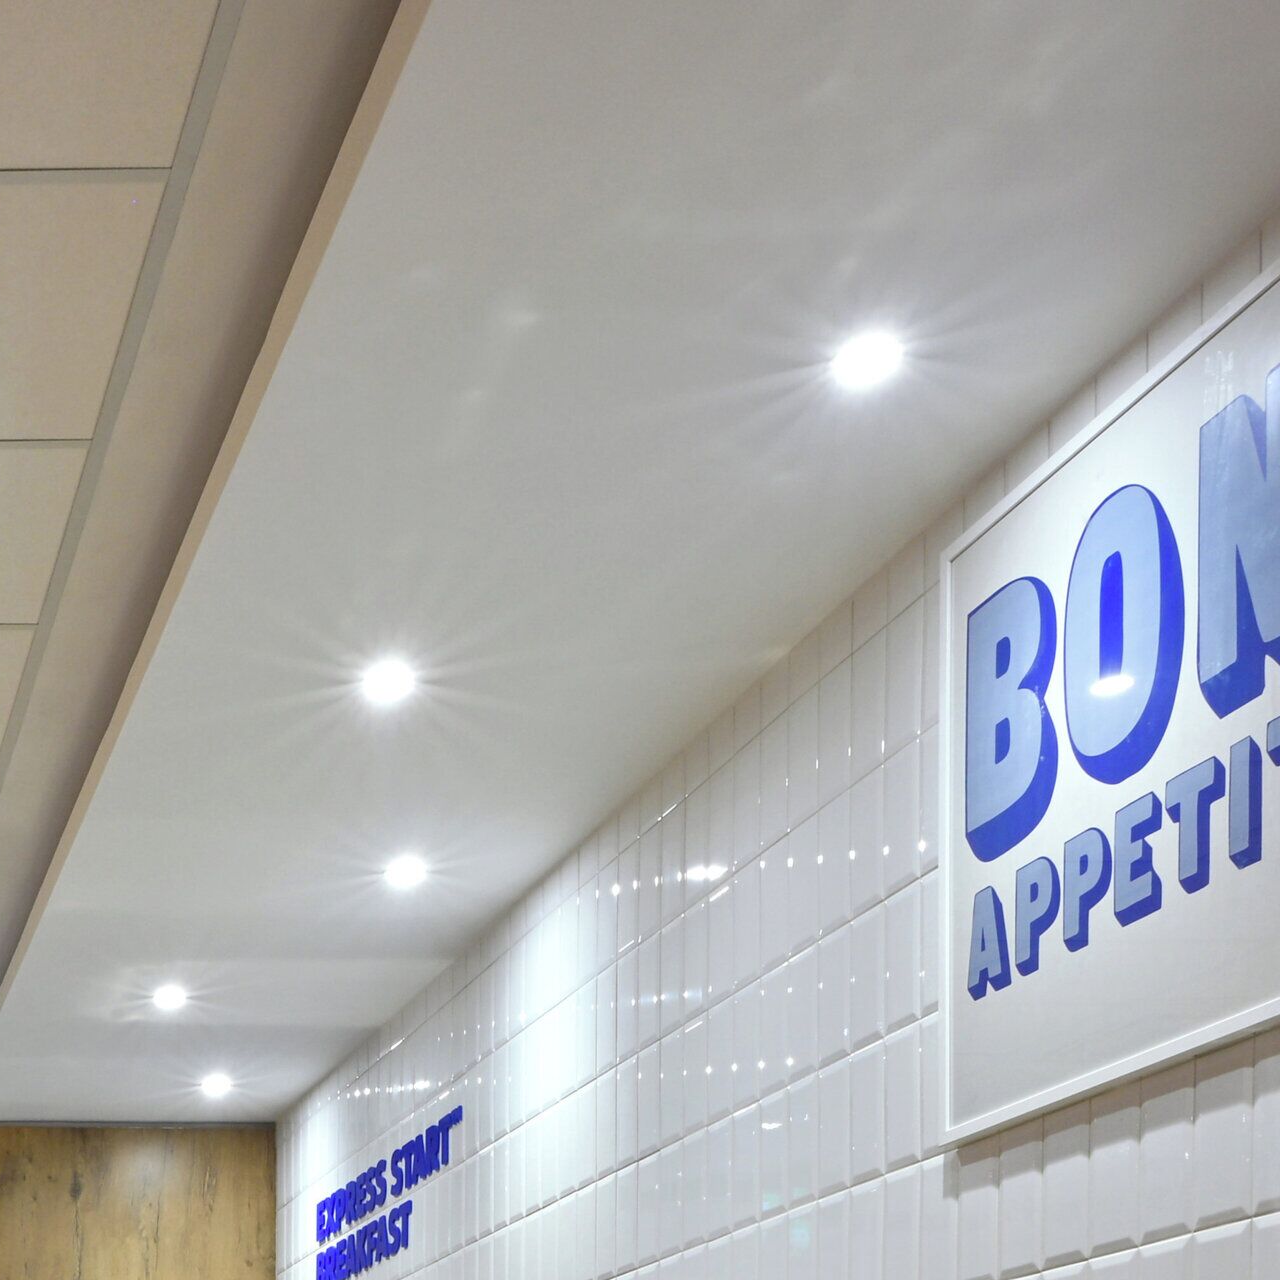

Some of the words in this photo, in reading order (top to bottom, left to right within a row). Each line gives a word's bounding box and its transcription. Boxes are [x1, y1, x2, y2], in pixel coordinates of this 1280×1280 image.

[966, 362, 1280, 863] BON
[967, 716, 1280, 1001] APPETI
[316, 1158, 387, 1245] EXPRESS
